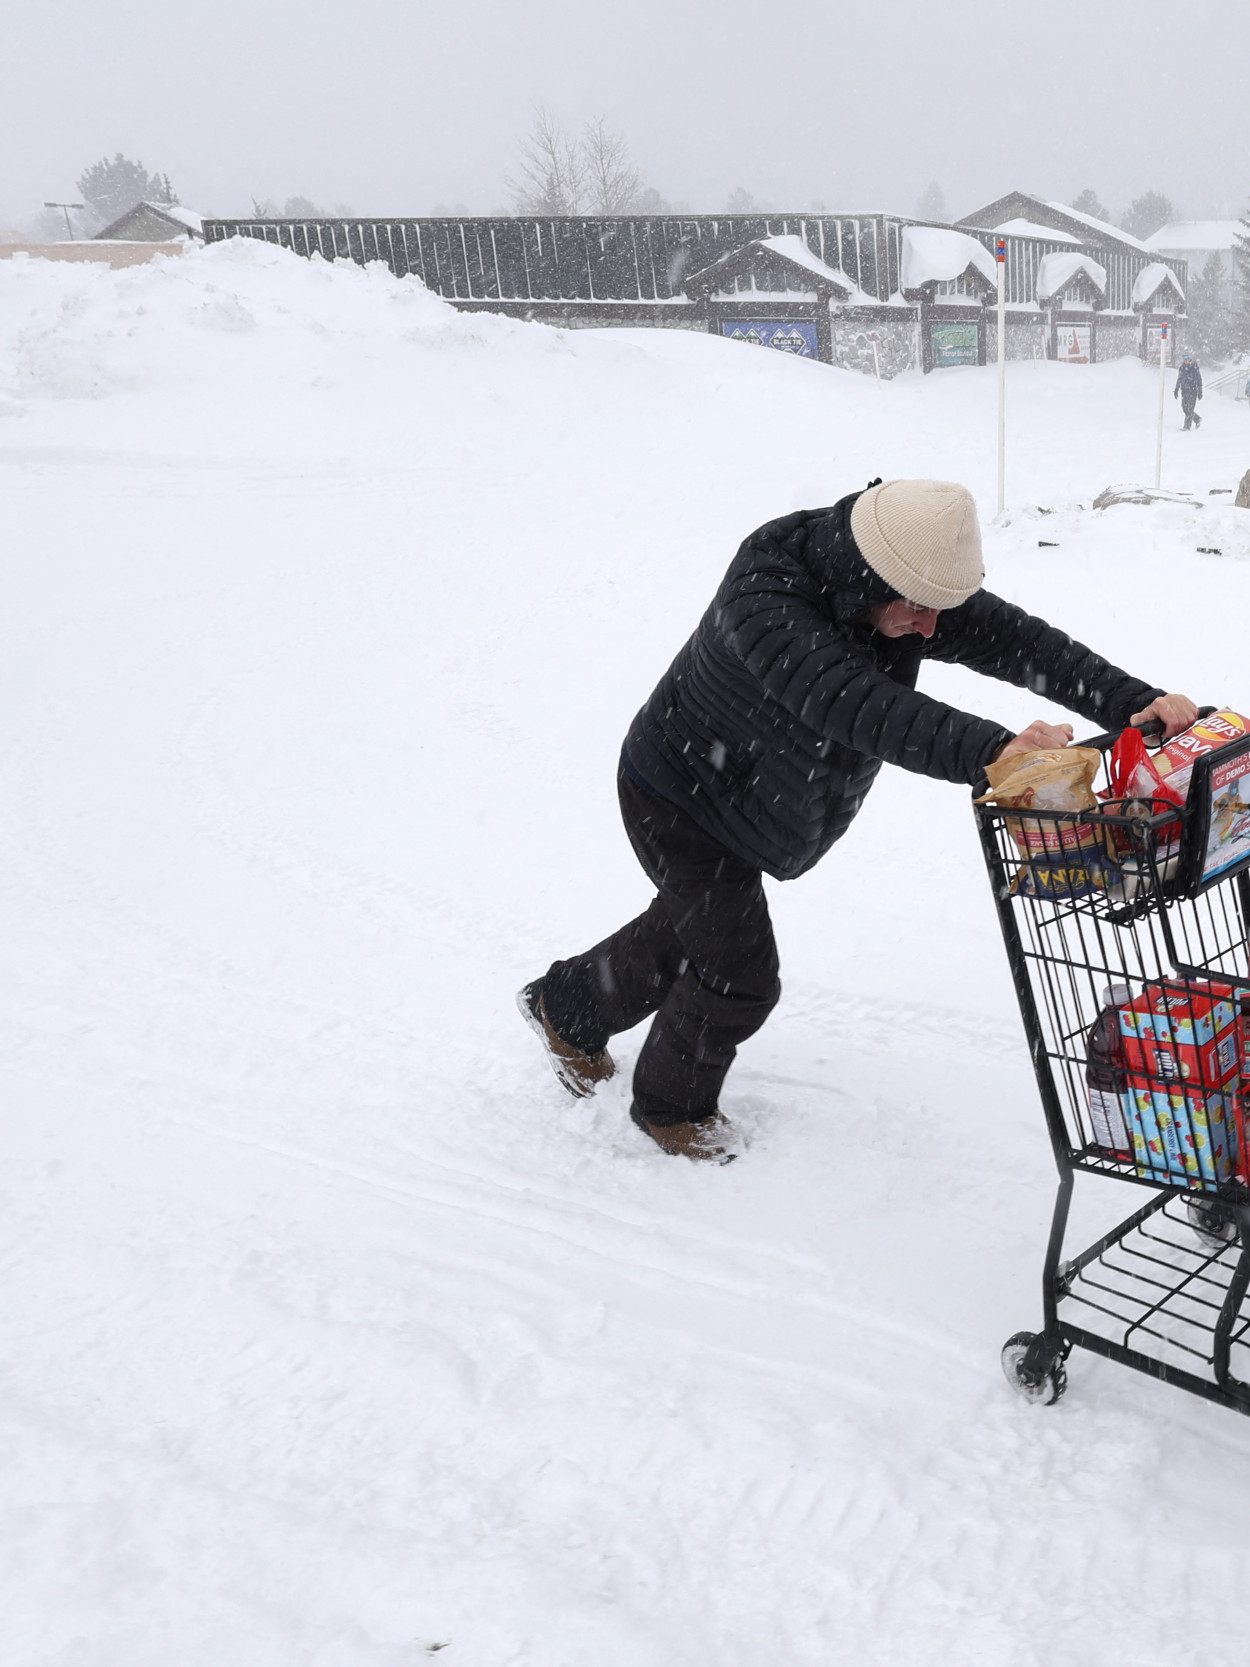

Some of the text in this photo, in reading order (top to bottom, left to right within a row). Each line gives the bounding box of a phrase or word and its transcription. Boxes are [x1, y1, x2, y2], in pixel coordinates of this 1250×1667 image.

[773, 338, 802, 346] BLACK TIE
[1174, 735, 1213, 756] av
[1215, 774, 1226, 786] OF
[1225, 764, 1246, 781] DEMO
